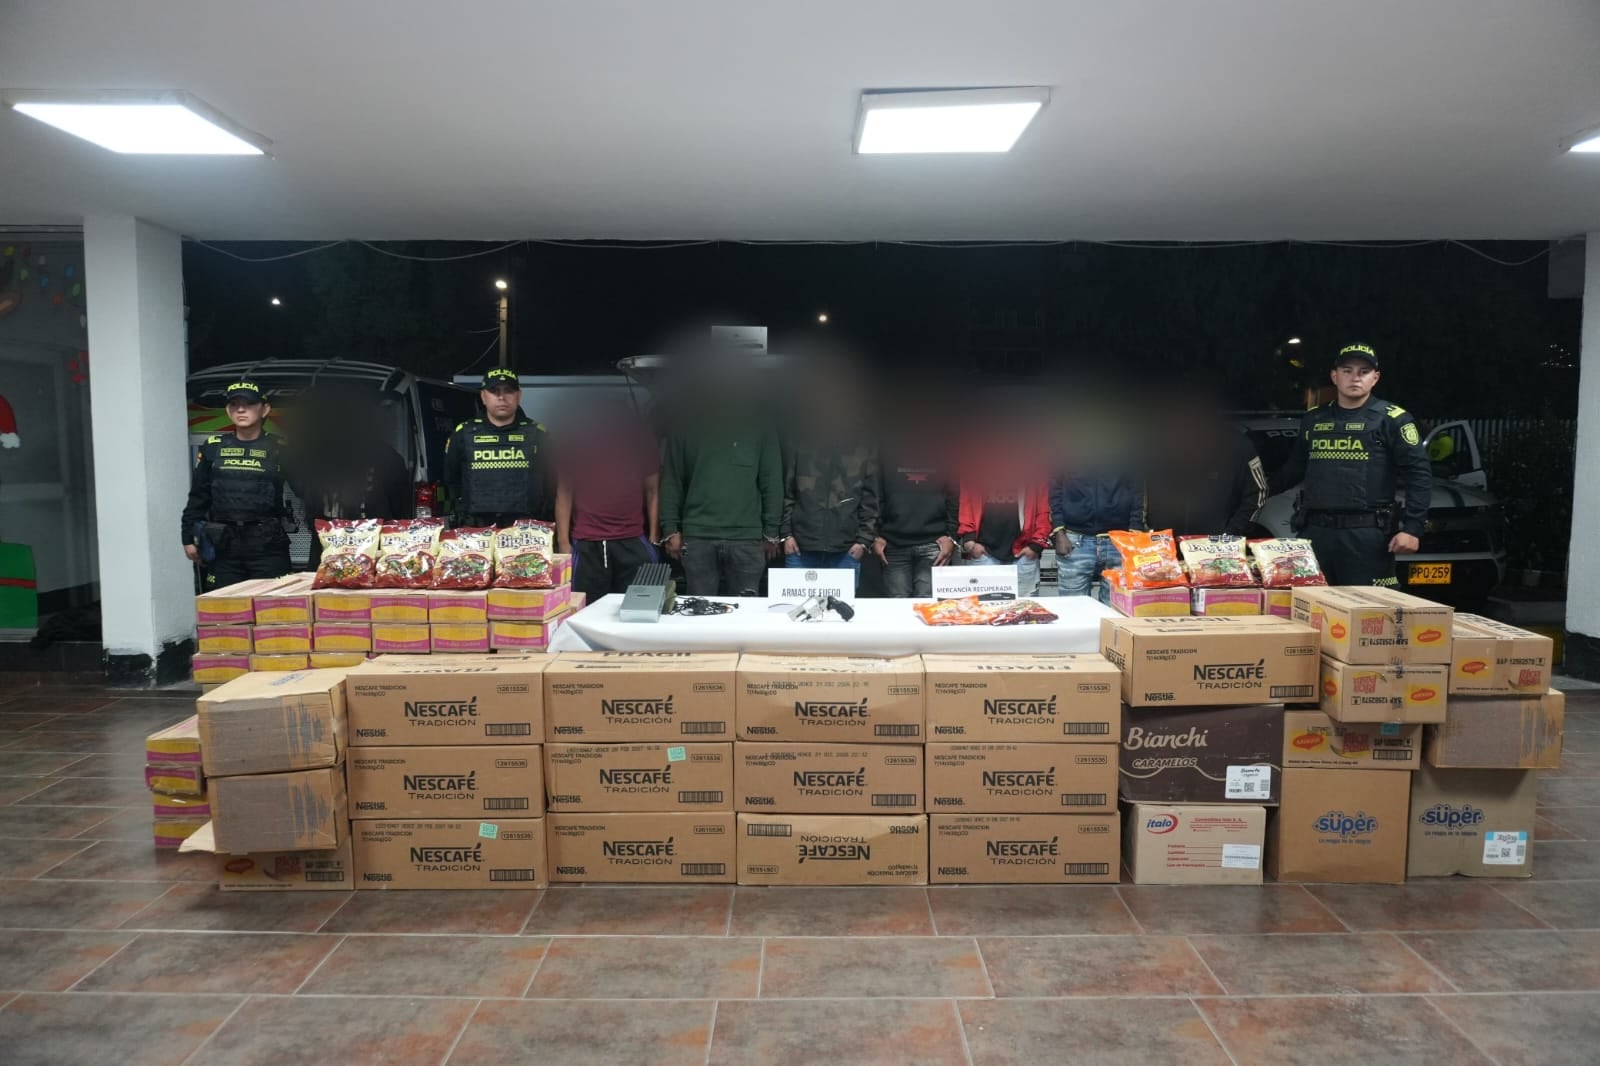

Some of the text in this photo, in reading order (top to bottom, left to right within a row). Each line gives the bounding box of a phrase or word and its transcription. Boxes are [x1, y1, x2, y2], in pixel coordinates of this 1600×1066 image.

[1312, 436, 1364, 450] POLICÍA
[474, 446, 525, 460] POLICÍA
[782, 588, 840, 598] ARMAS DE FUEGO
[1194, 659, 1264, 680] NESCAFÉ
[1197, 681, 1262, 689] TRADICIÓN
[404, 696, 477, 717] NESCAFÉ
[602, 695, 673, 715] NESCAFÉ
[795, 698, 868, 717] NESCAFÉ
[984, 695, 1056, 715] NESCAFÉ
[606, 716, 672, 724] TRADICIÓN
[1124, 727, 1208, 750] Bianchi
[1132, 758, 1198, 769] CARAMELOS
[404, 771, 475, 790] NESCAFÉ
[600, 765, 671, 784] NESCAFÉ
[794, 767, 865, 787] NESCAFÉ
[983, 766, 1055, 786] NESCAFÉ
[798, 788, 863, 796] TRADICIÓN
[1146, 818, 1172, 829] italo
[410, 843, 481, 862] NESCAFÉ
[604, 837, 674, 856] NESCAFÉ
[799, 845, 870, 864] NESCAFÉ
[987, 836, 1058, 856] NESCAFÉ
[608, 857, 672, 865] TRADICIÓN
[990, 857, 1056, 865] TRADICIÓN
